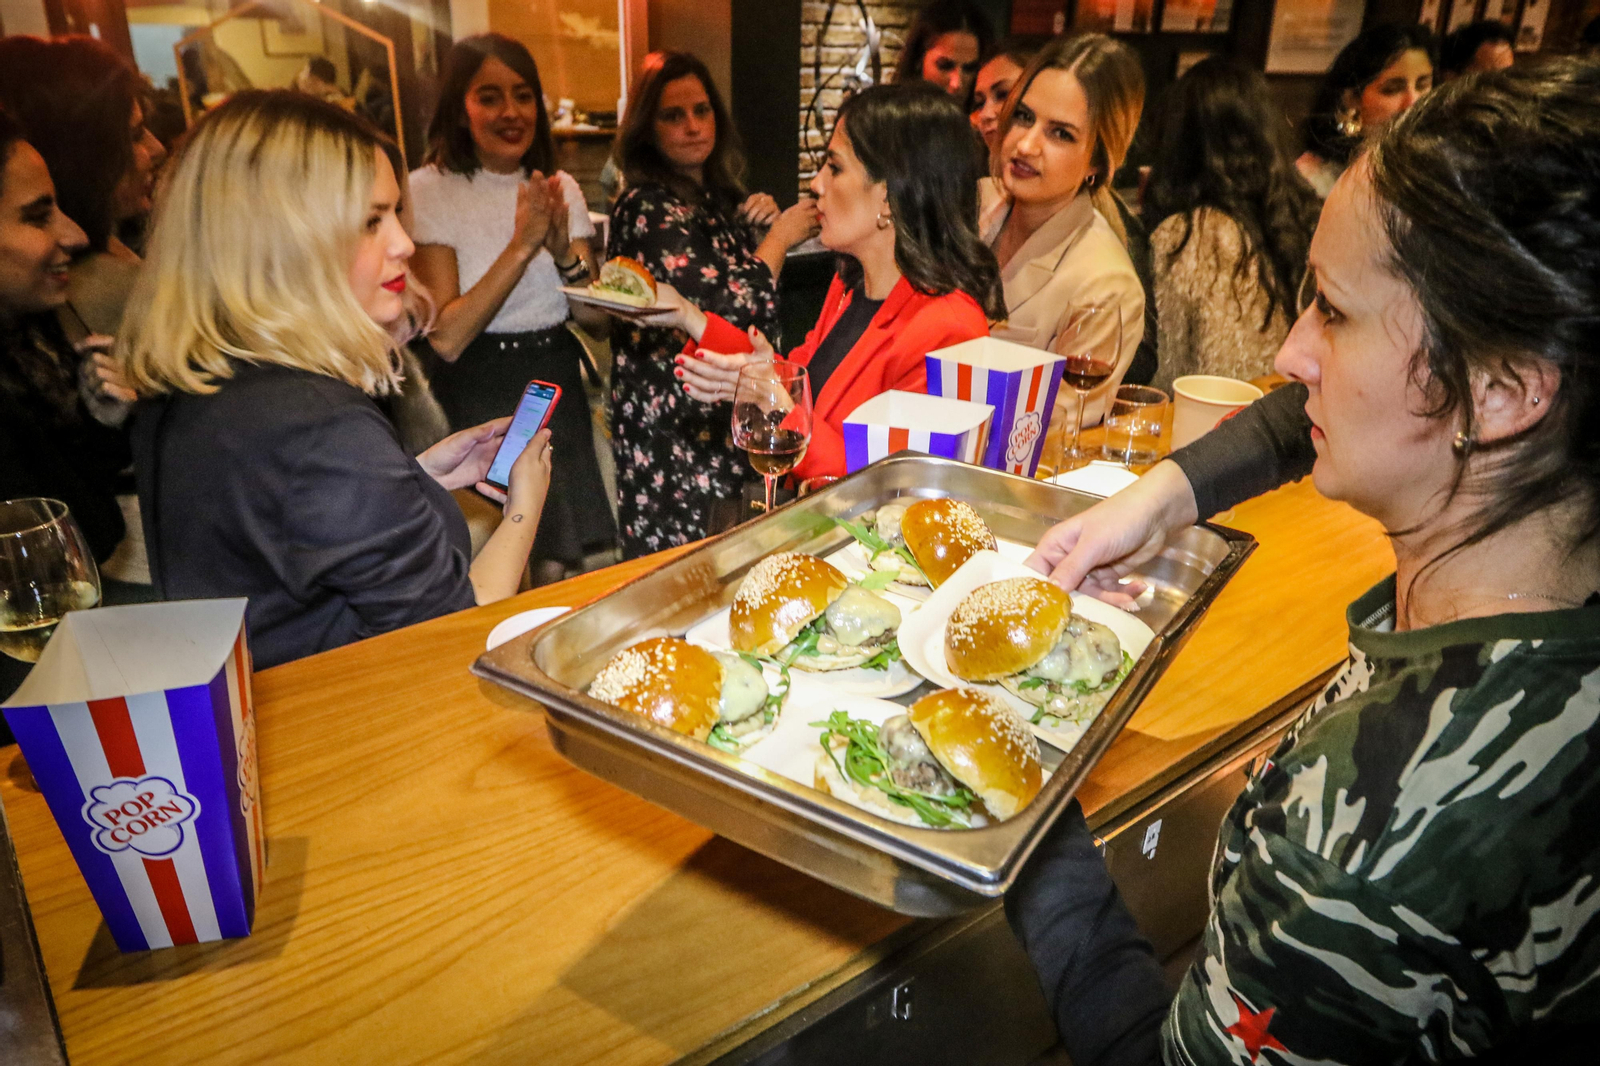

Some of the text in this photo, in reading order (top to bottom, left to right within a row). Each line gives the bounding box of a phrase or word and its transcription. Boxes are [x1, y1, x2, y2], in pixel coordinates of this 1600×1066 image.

[1011, 427, 1037, 455] CORN
[1014, 421, 1033, 443] POP
[102, 791, 155, 826] POP
[110, 800, 183, 843] CORN
